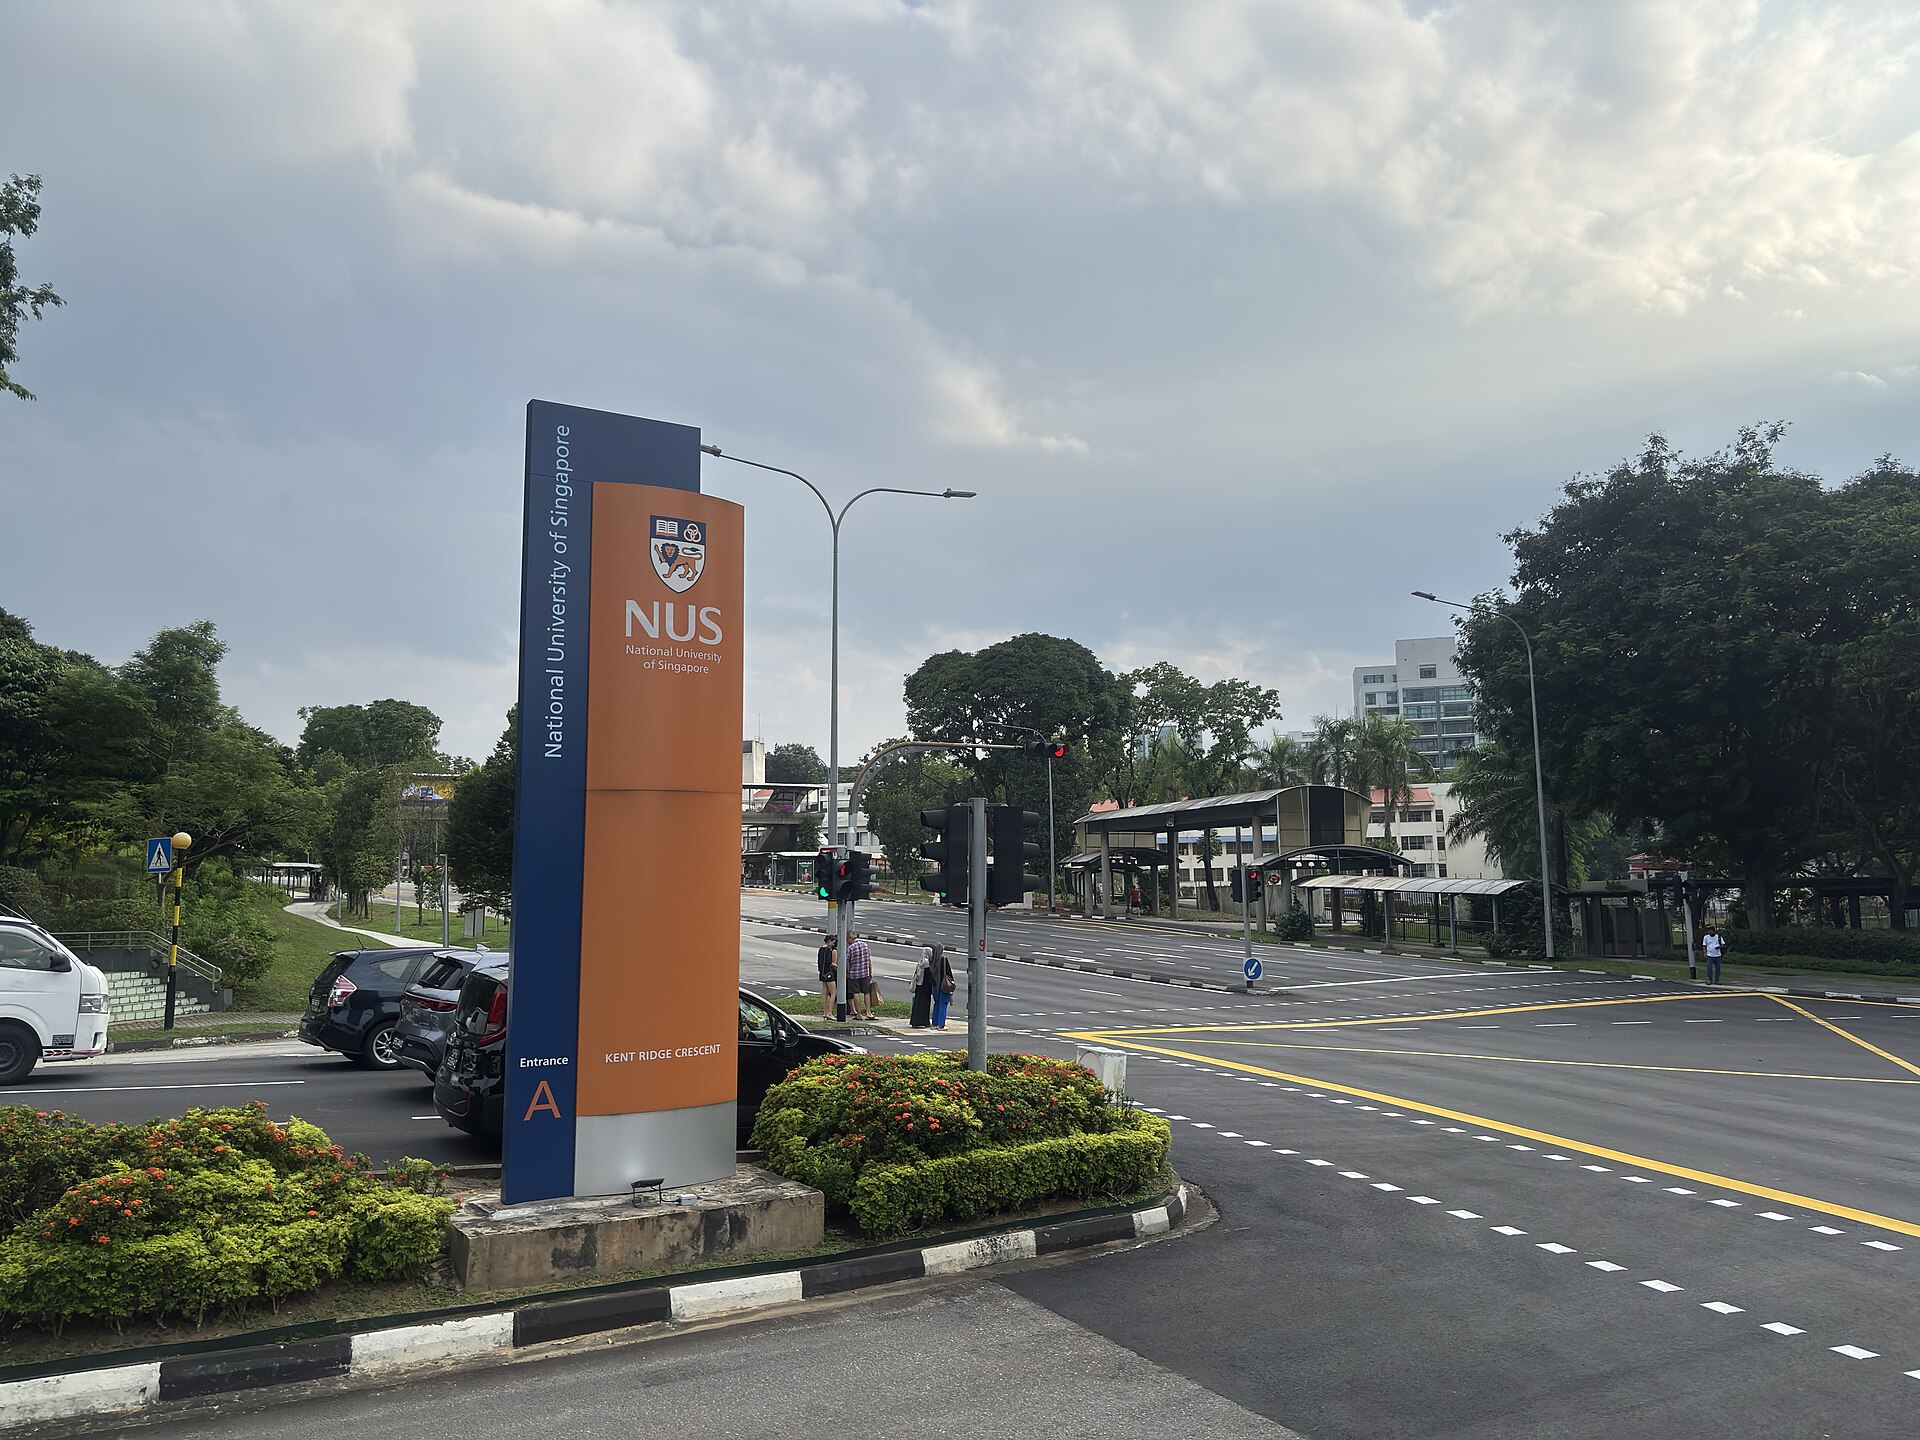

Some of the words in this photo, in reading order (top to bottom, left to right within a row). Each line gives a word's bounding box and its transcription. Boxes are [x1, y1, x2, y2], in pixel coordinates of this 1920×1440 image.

[550, 425, 573, 527] Singapore
[549, 531, 567, 554] of
[547, 560, 571, 661] University
[625, 599, 723, 645] NUS
[626, 645, 673, 657] National
[676, 648, 722, 664] University
[643, 660, 656, 669] of
[658, 660, 709, 674] Singapore
[545, 669, 564, 758] National
[979, 939, 985, 951] 9
[520, 1056, 569, 1068] Entrance
[605, 1052, 636, 1063] KENT
[639, 1049, 672, 1061] RIDGE
[675, 1044, 721, 1058] CRESCENT
[523, 1080, 561, 1121] A
